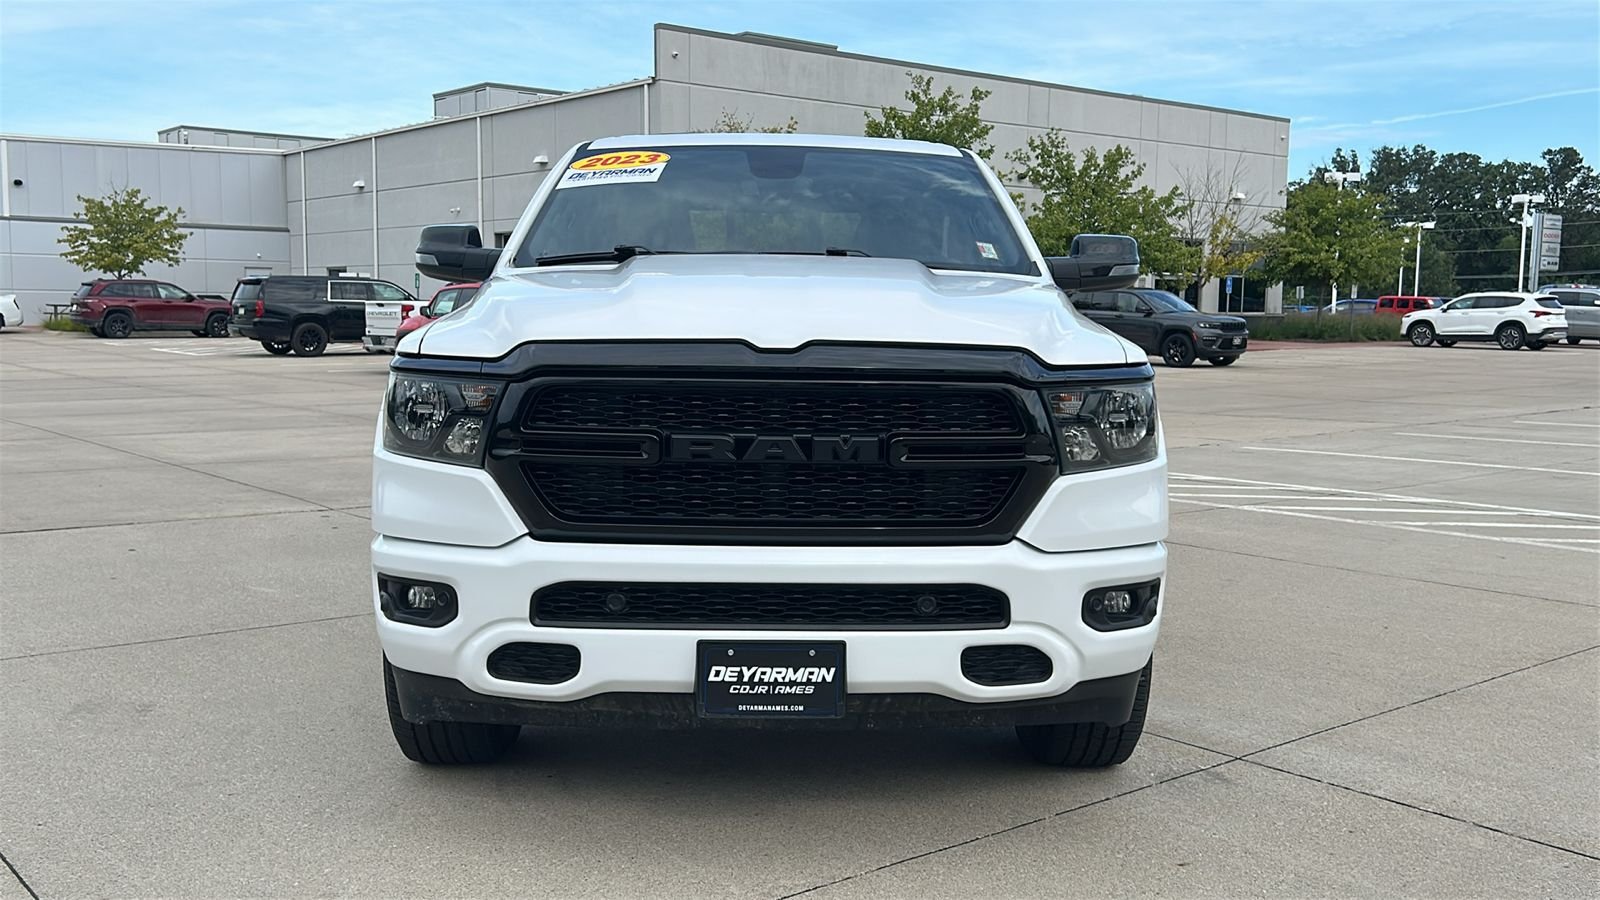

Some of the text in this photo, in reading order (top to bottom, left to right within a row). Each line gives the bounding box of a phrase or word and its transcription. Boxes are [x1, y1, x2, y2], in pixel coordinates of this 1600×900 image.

[580, 153, 662, 168] 2023
[567, 167, 658, 180] DEYARMAN
[671, 433, 879, 462] RAM
[707, 665, 836, 683] DEYARMAN
